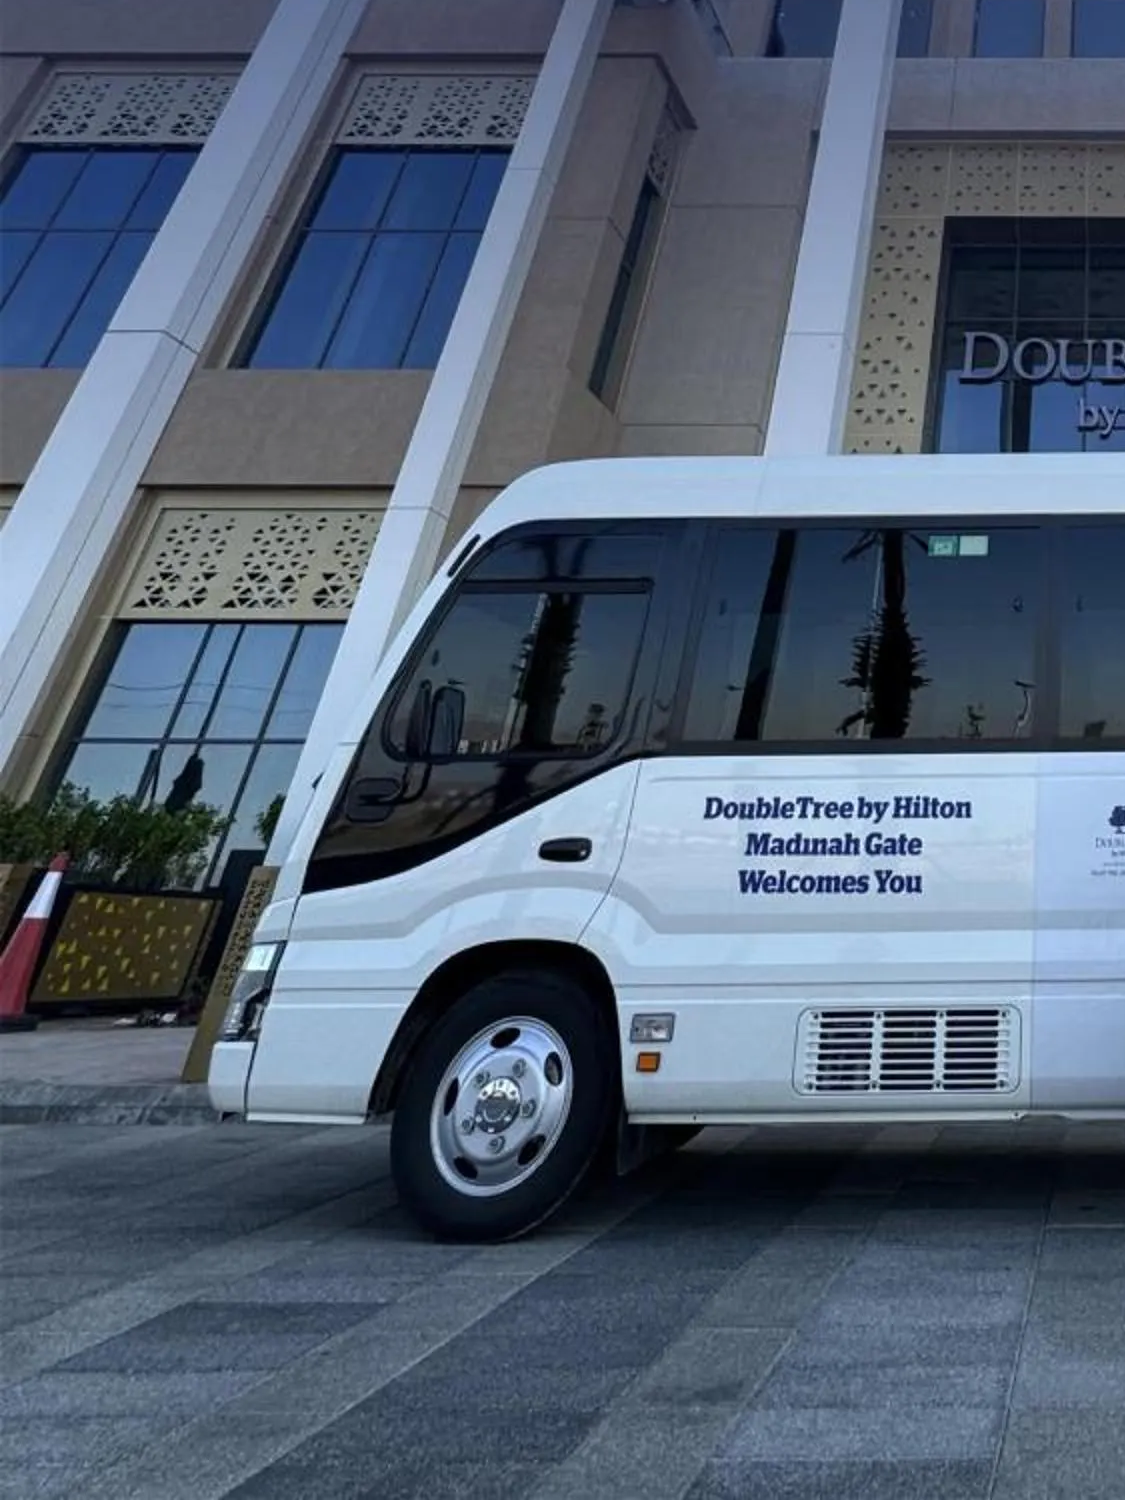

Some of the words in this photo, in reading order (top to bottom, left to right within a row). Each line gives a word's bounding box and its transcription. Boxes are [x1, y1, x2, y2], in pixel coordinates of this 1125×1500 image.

[1078, 399, 1121, 438] by
[704, 796, 854, 820] DoubleTree
[857, 796, 889, 824] by
[891, 795, 973, 819] Hilton
[864, 833, 922, 856] Gate
[738, 869, 869, 894] Welcomes
[874, 869, 922, 894] You
